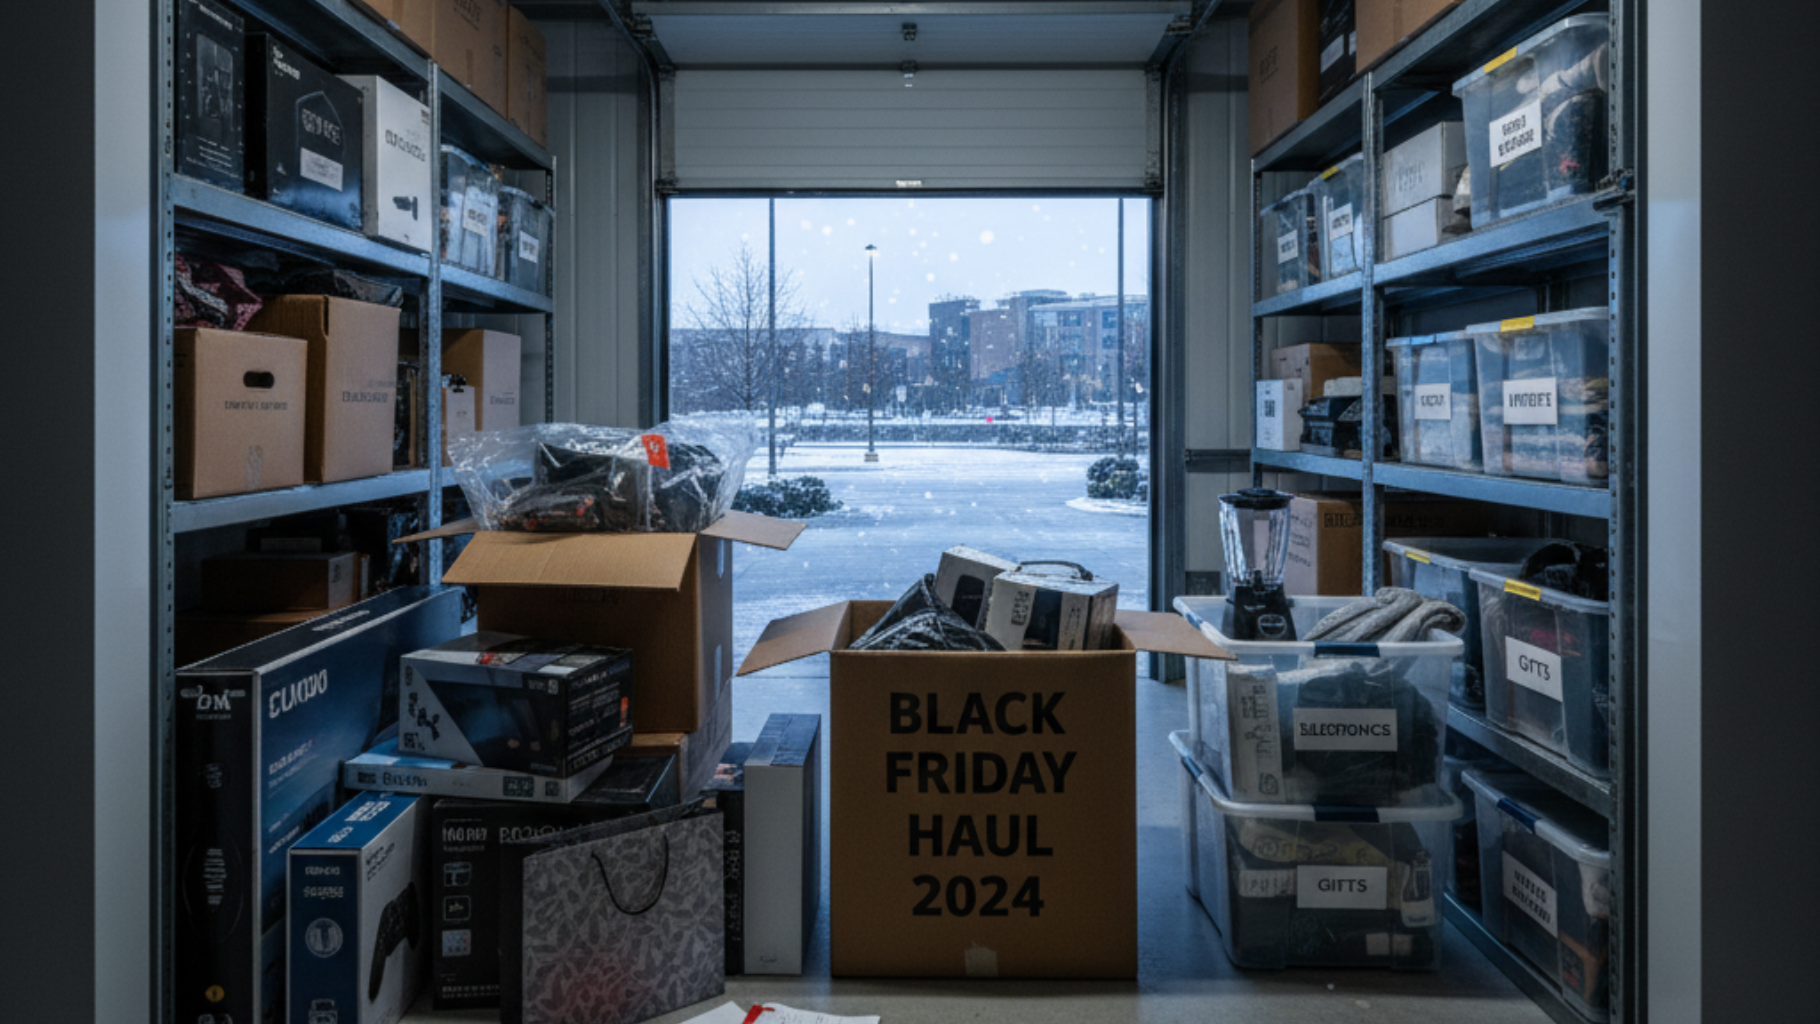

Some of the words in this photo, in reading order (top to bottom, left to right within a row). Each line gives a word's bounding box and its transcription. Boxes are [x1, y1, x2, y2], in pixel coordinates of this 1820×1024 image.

[889, 691, 1066, 736] BLACK
[886, 750, 1078, 795] FRIDAY
[908, 813, 1054, 858] HAUL
[912, 874, 1045, 918] 2024
